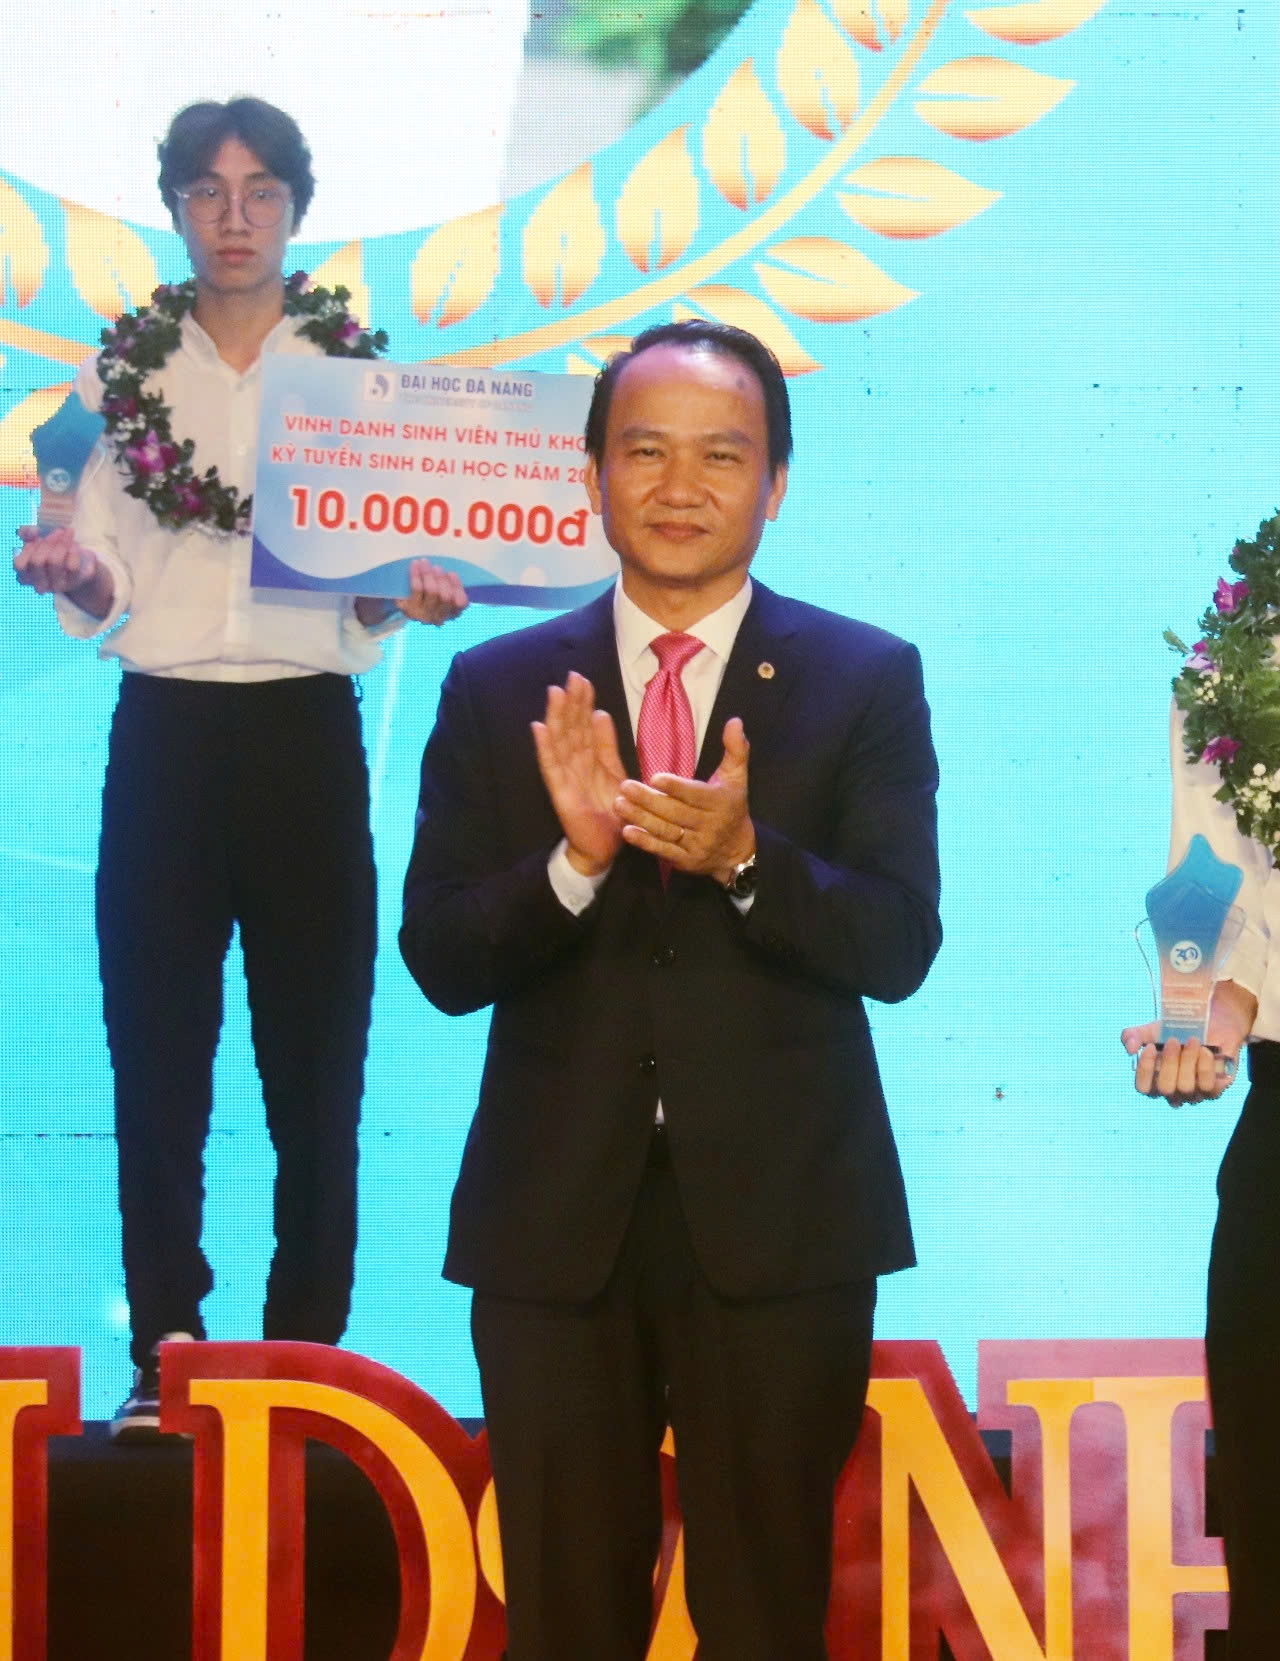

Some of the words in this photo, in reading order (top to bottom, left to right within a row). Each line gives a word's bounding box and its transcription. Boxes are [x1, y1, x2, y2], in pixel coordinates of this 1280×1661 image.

[285, 415, 333, 434] VINH
[339, 418, 396, 438] DANH
[403, 423, 448, 442] SINH
[455, 424, 499, 446] VIÊN
[505, 427, 542, 449] THỦ
[548, 434, 587, 453] KHO
[271, 444, 298, 464] KỲ
[304, 442, 362, 468] TUYỂN
[368, 453, 415, 472] SINH
[421, 457, 455, 479] ĐẠI
[463, 461, 508, 482] HỌC
[514, 461, 560, 481] NĂM
[567, 466, 585, 483] 20
[291, 487, 589, 547] 10.000.000đ
